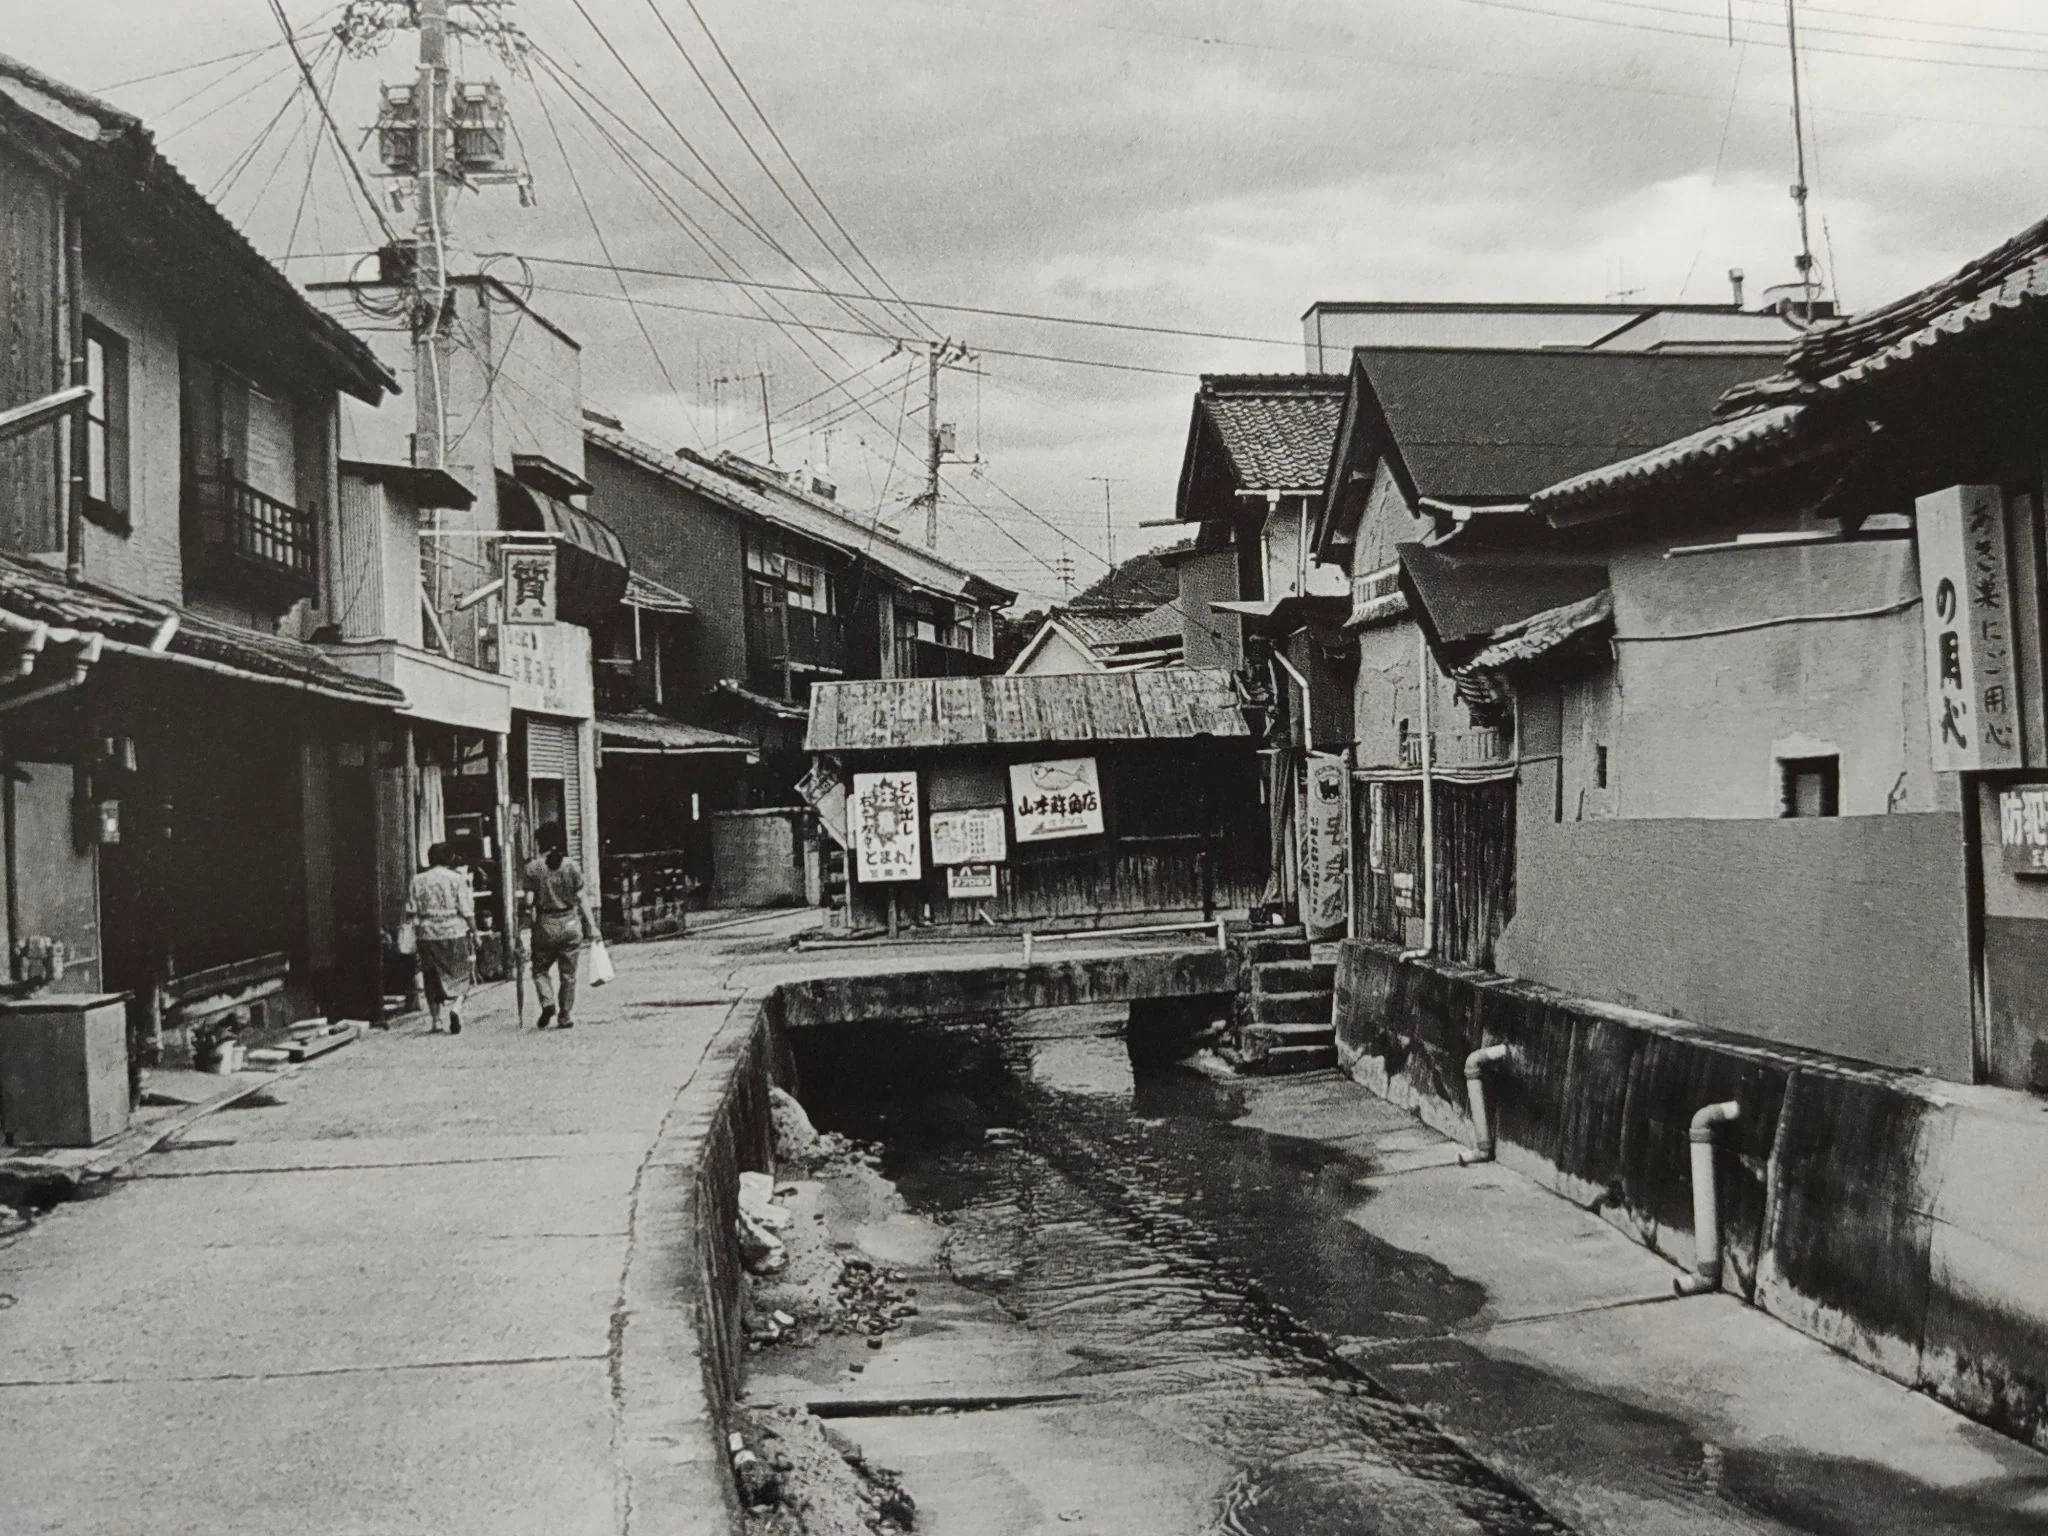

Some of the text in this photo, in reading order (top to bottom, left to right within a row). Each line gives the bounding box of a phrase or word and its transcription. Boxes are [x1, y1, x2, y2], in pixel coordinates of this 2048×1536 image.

[512, 559, 551, 607] 質
[1930, 508, 1967, 750] の用心
[1018, 790, 1097, 818] 山本鮮魚店
[2000, 791, 2048, 847] 防犯
